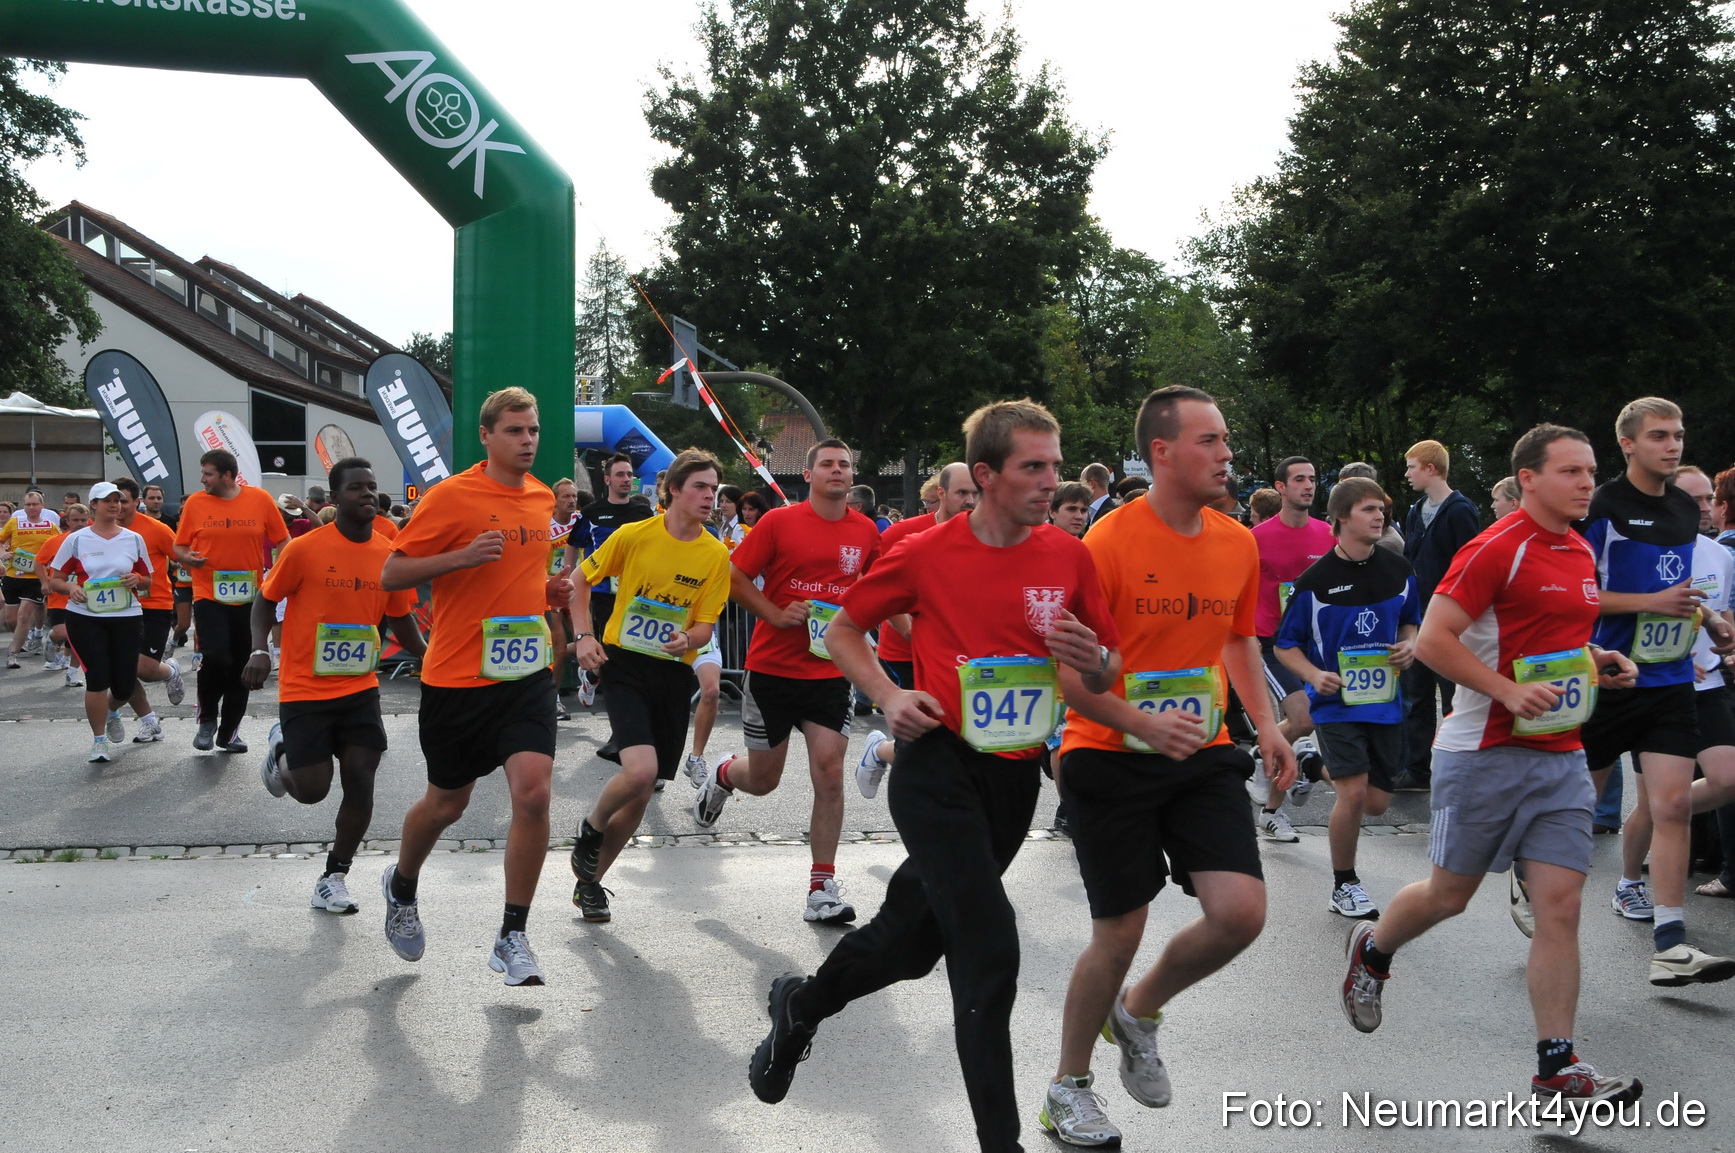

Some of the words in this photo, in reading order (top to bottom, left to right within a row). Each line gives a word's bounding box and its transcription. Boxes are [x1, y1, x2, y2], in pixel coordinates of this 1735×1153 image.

[345, 50, 527, 199] AOK
[203, 520, 225, 529] EURO
[233, 519, 257, 527] POLES
[1628, 518, 1655, 527] saller
[529, 529, 551, 542] POLE
[14, 556, 33, 569] 431
[218, 582, 249, 596] 614
[325, 577, 354, 589] EURO
[362, 580, 385, 591] POL
[1327, 584, 1354, 595] saller
[96, 588, 116, 604] 41
[1135, 598, 1184, 615] EURO
[1201, 598, 1235, 616] POLE
[626, 615, 675, 644] 208
[1640, 622, 1683, 648] 301
[631, 637, 655, 648] Andreas
[322, 642, 367, 663] 564
[490, 638, 539, 665] 565
[1345, 668, 1386, 691] 299
[1548, 677, 1581, 713] 56
[972, 689, 1043, 729] 947
[983, 730, 1016, 738] Thomas
